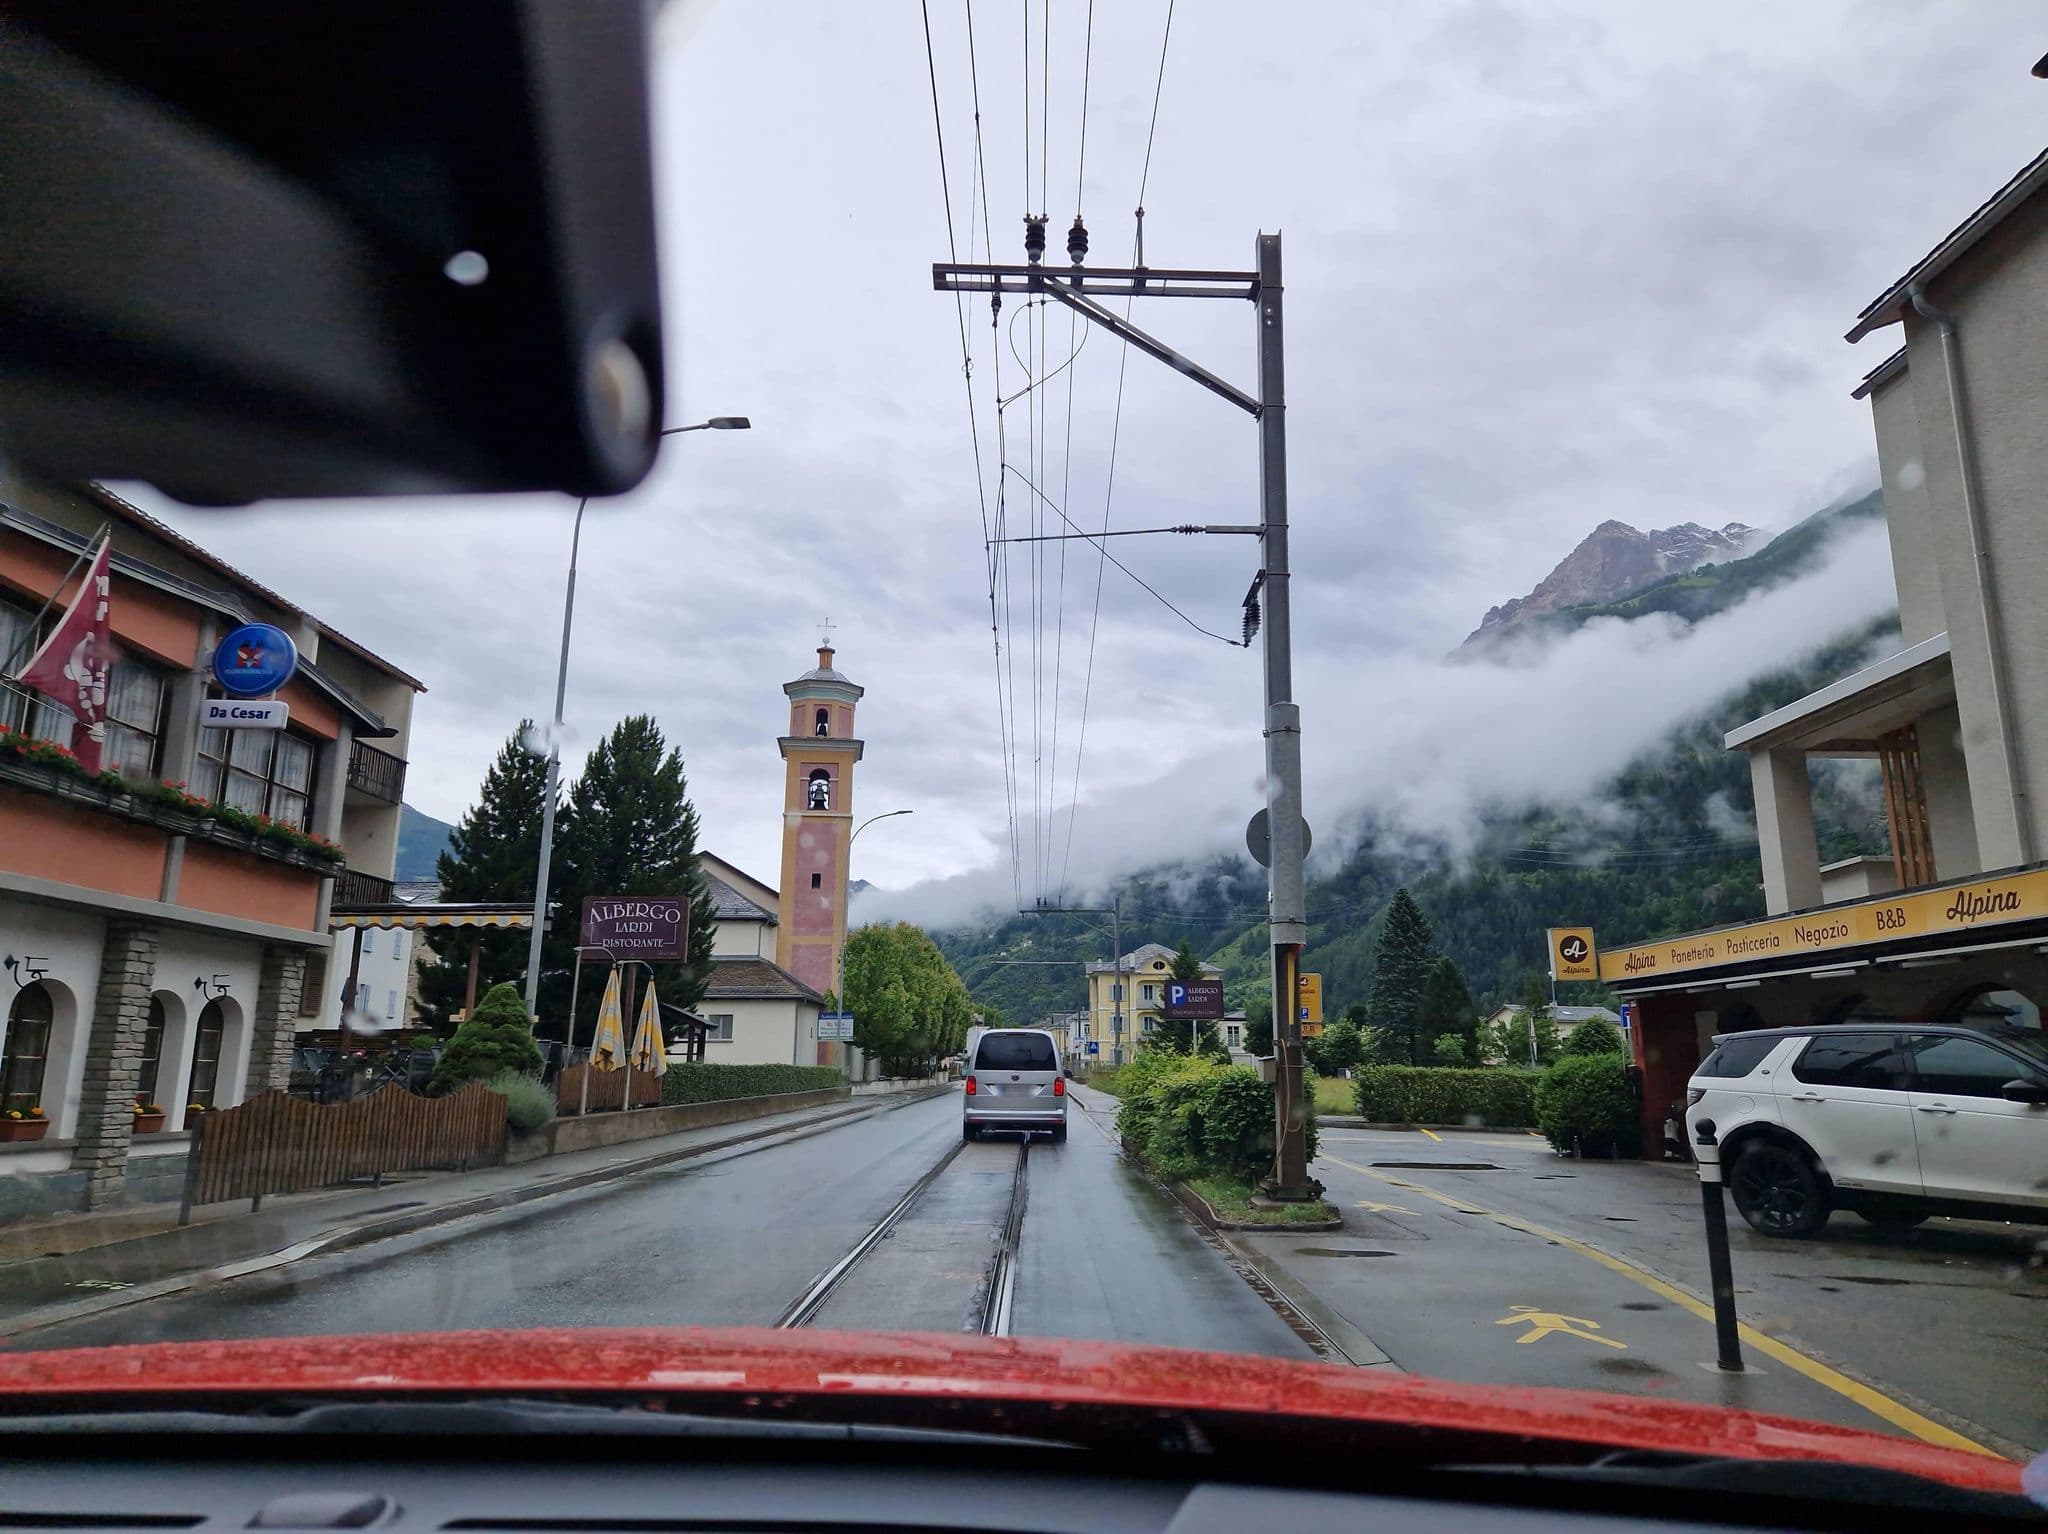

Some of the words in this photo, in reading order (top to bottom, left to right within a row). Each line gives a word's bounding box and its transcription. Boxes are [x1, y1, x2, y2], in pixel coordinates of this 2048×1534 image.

[210, 707, 226, 718] Da
[231, 707, 271, 719] Cesar
[589, 902, 681, 925] ALBERGO
[615, 921, 653, 933] LARDI
[1624, 952, 1657, 974] Alpina
[1671, 944, 1715, 964] Panetteria
[1726, 931, 1780, 955] Pasticceria
[1794, 920, 1849, 946] Negozio
[1876, 907, 1906, 931] B&B
[1946, 887, 2022, 923] Alpina
[602, 938, 664, 948] RISTORANTE
[1562, 966, 1590, 975] Alpina
[1171, 985, 1184, 1004] P
